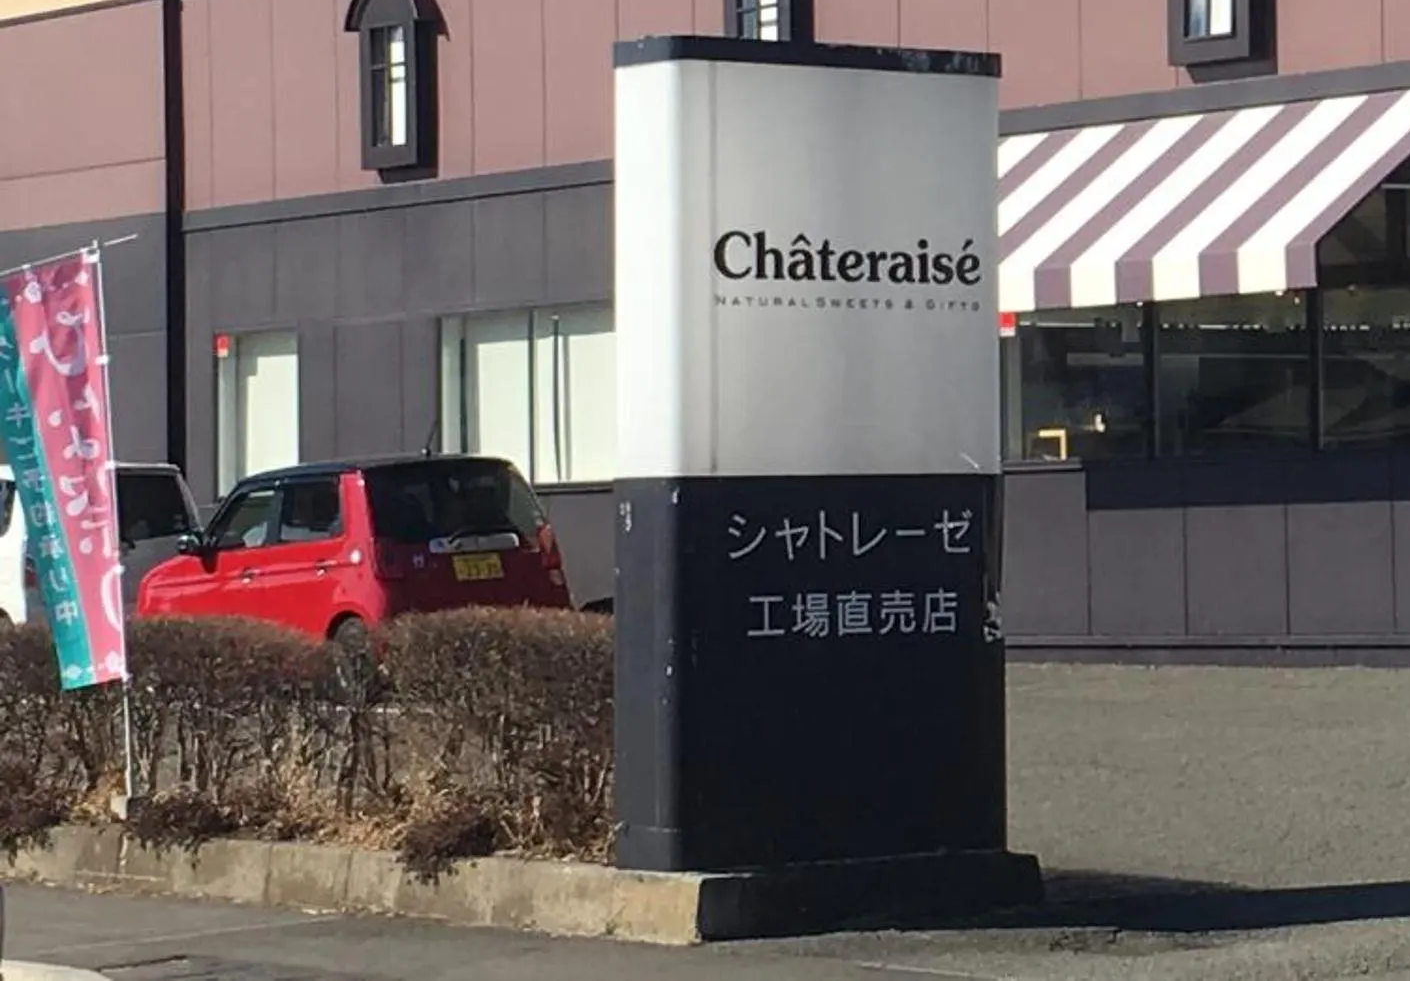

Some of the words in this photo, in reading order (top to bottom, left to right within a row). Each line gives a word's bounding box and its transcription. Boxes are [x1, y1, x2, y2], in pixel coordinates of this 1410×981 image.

[713, 230, 982, 286] Châteraisé
[926, 298, 981, 313] GIFTS
[728, 509, 972, 560] シャトレーゼ
[746, 588, 959, 639] 工場直売店
